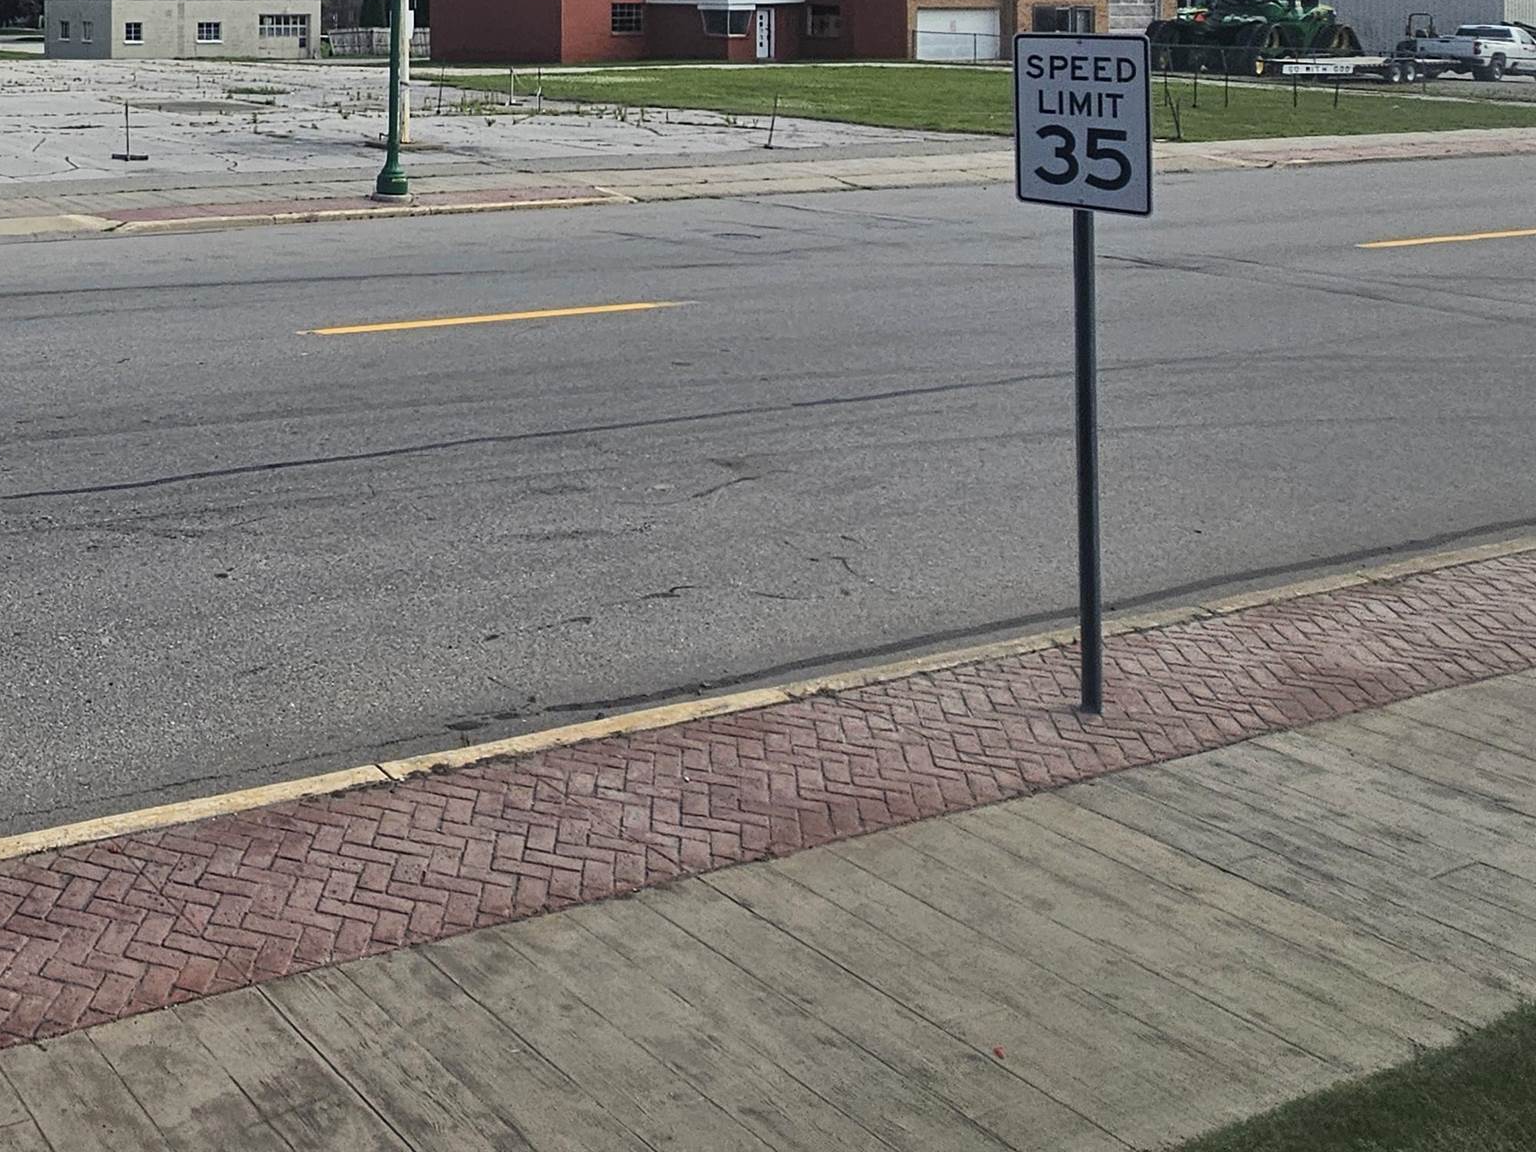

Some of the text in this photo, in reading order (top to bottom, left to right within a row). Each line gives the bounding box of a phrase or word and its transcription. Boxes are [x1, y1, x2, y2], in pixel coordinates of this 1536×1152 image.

[1026, 54, 1137, 83] SPEED
[1038, 89, 1124, 118] LIMIT
[1034, 124, 1132, 191] 35
